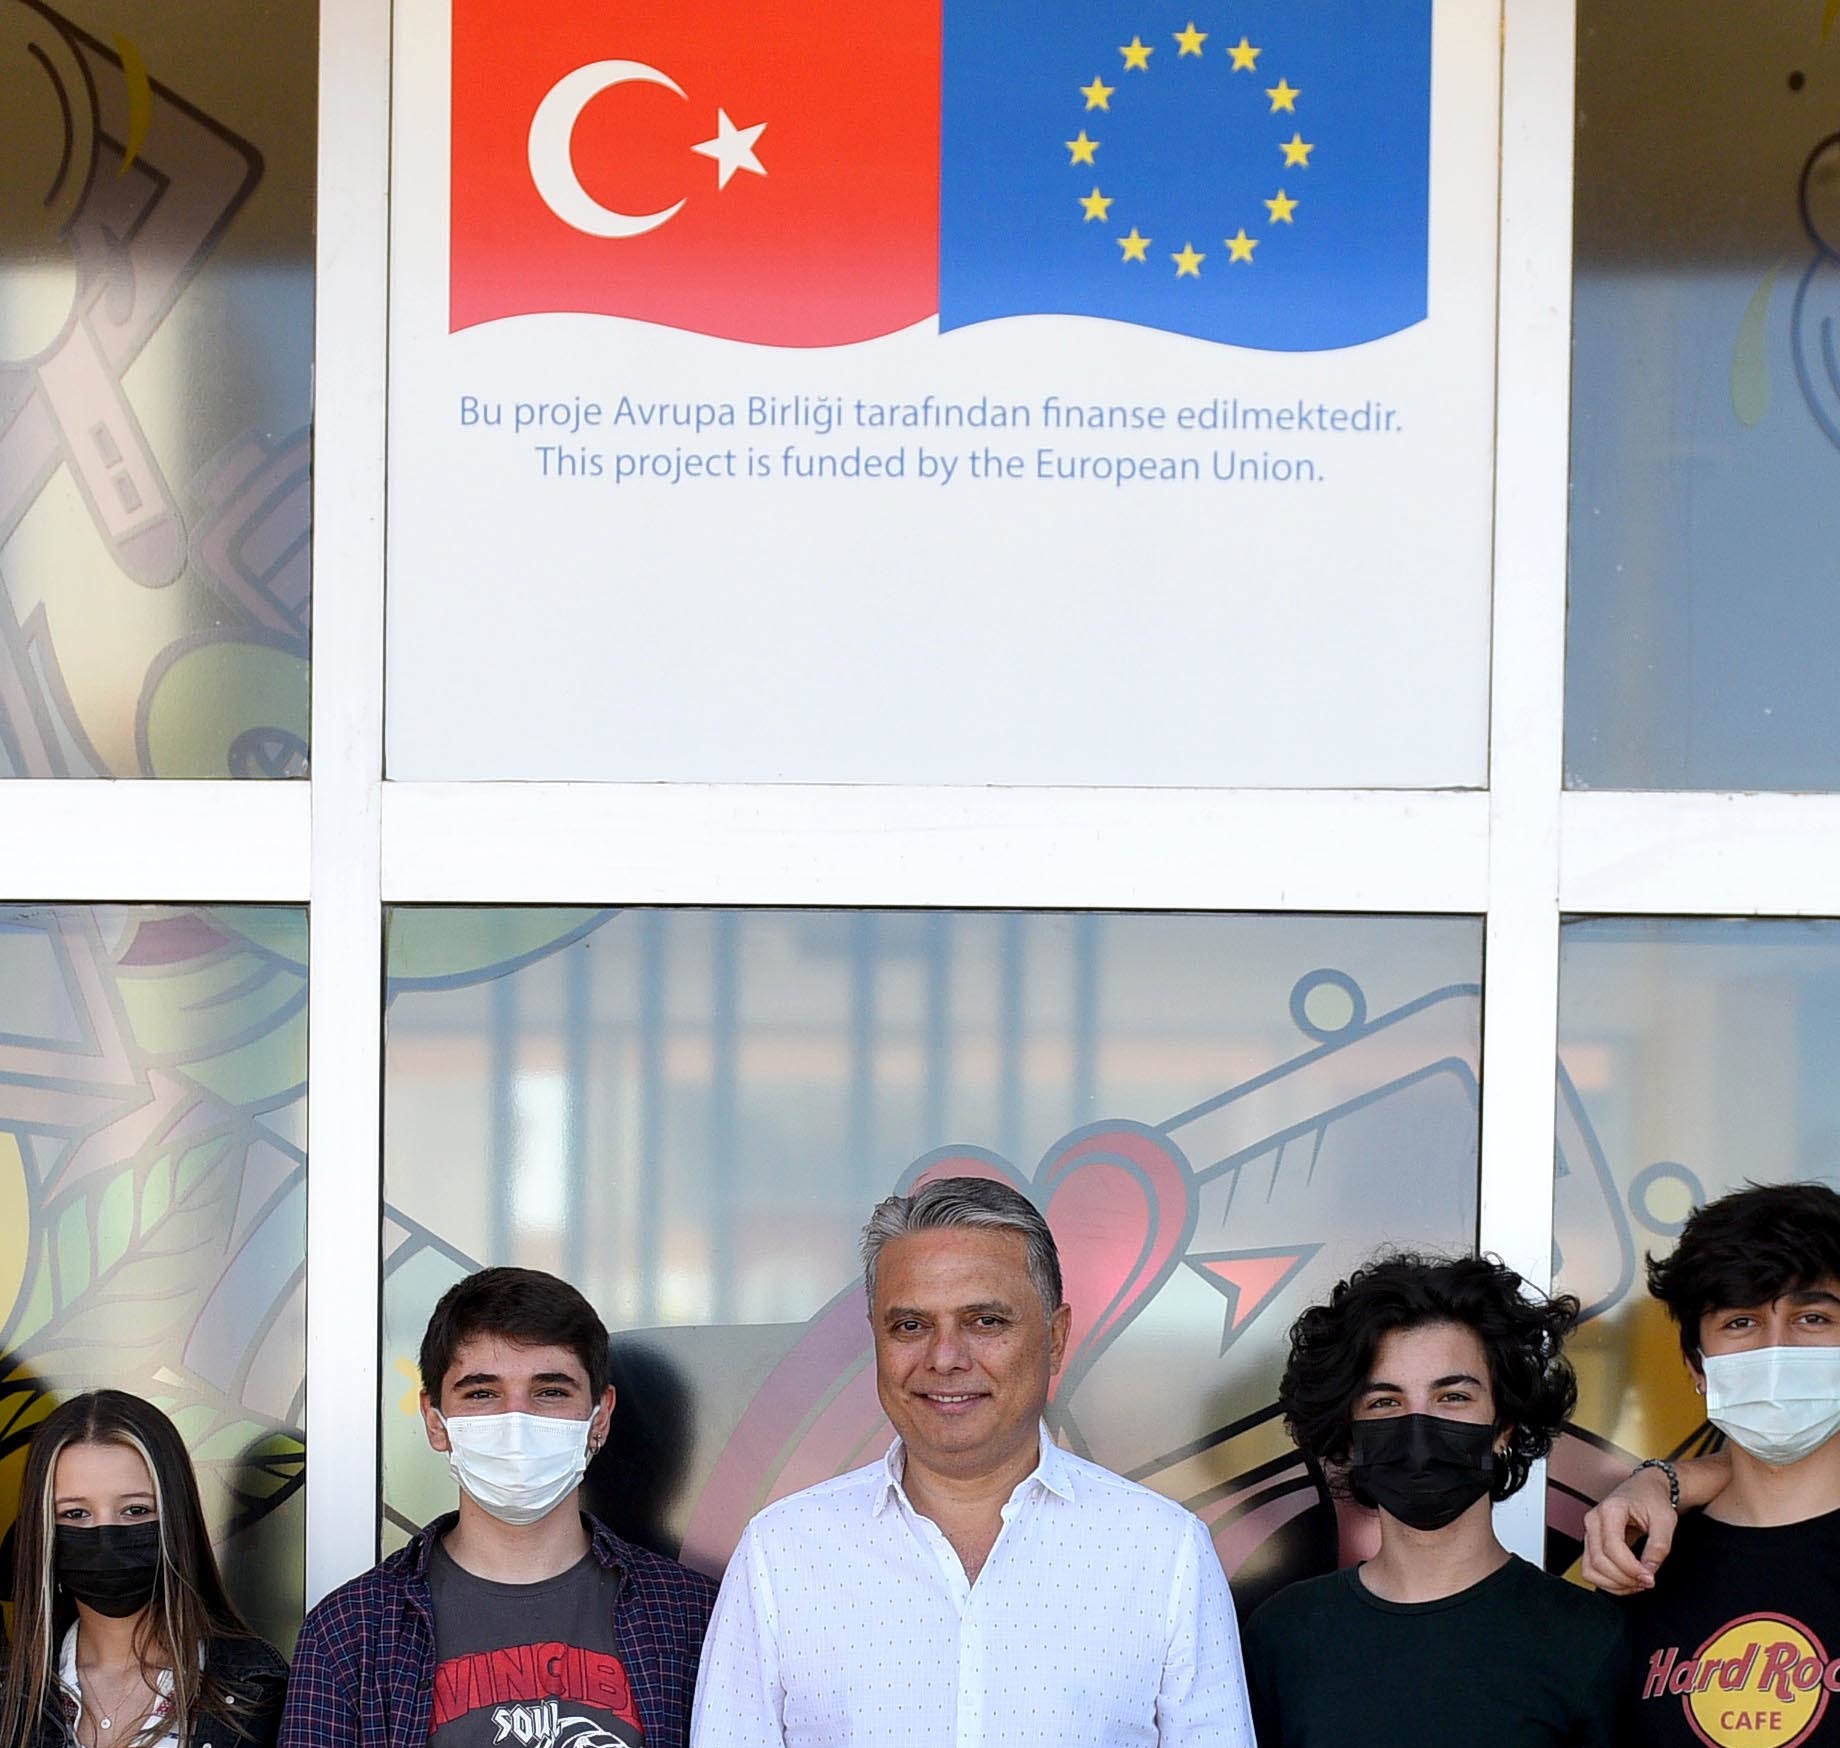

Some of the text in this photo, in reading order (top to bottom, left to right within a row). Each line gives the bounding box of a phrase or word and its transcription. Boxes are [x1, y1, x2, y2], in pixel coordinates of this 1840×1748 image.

[461, 395, 1402, 434] Bu proje Avrupa Birliği tarafından finanse edilmektedir.
[535, 445, 1324, 487] This project is funded by the European Union.
[1642, 1643, 1761, 1700] Hard
[1720, 1711, 1782, 1731] CAFE
